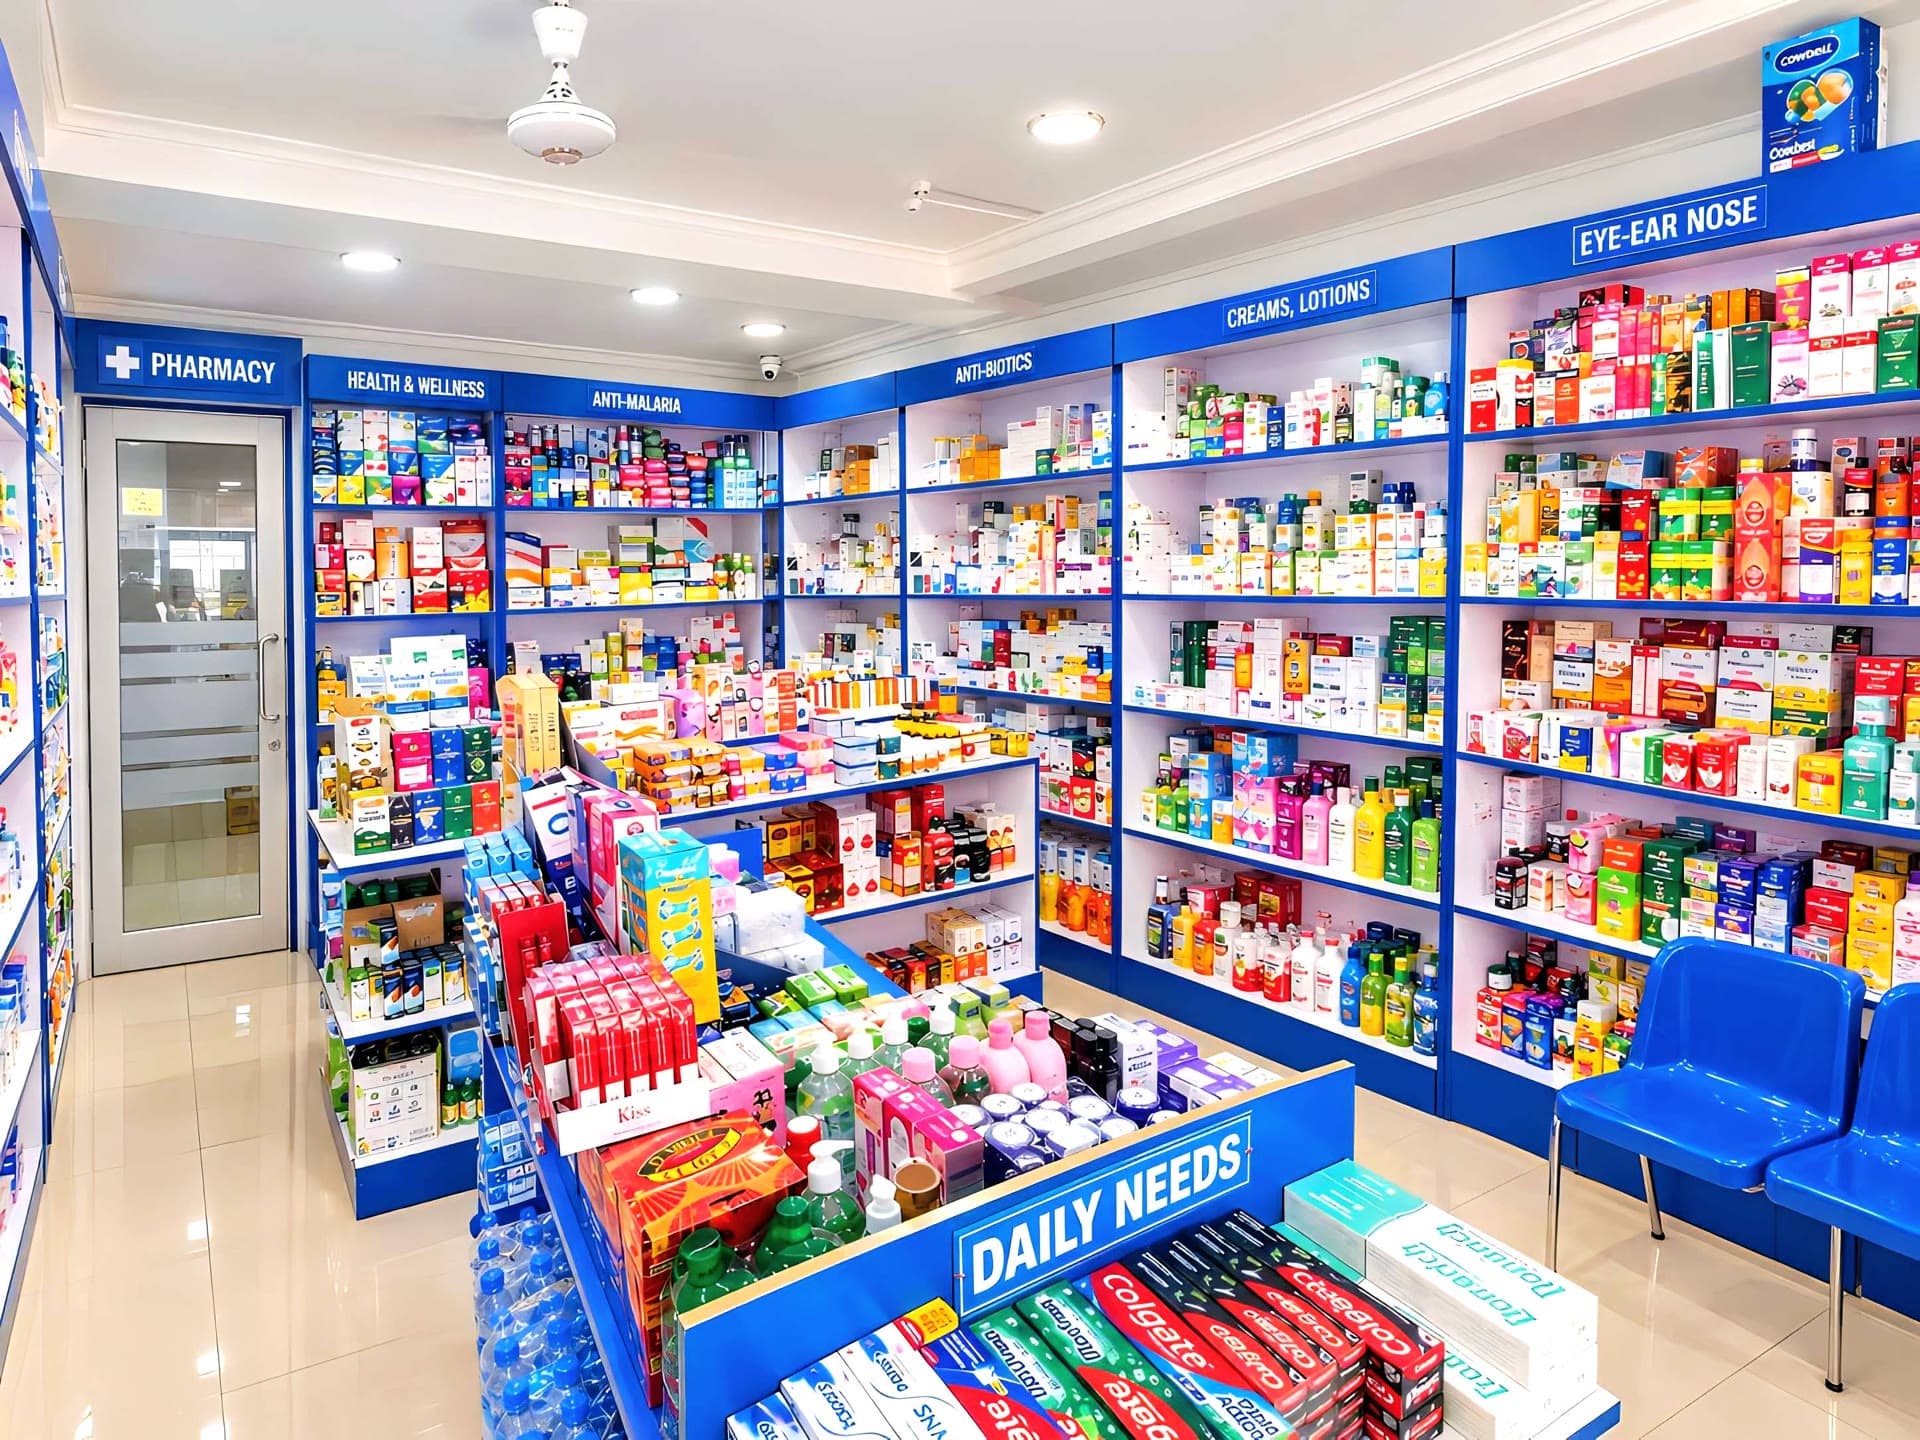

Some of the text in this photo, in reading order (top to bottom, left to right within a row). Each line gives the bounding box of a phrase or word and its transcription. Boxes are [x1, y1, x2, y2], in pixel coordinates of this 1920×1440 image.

[1580, 195, 1758, 257] EYE-EAR NOSE
[1227, 278, 1370, 329] CREAMS, LOTIONS
[151, 351, 276, 385] PHARMACY
[347, 370, 485, 399] HEALTH & WELLNESS
[955, 352, 1033, 385] ANTI-BIOTICS
[592, 391, 682, 414] ANTI-MALARIA
[618, 1105, 652, 1124] Kiss
[972, 1132, 1242, 1296] DAILY NEEDS
[1103, 1273, 1216, 1370] Colgate
